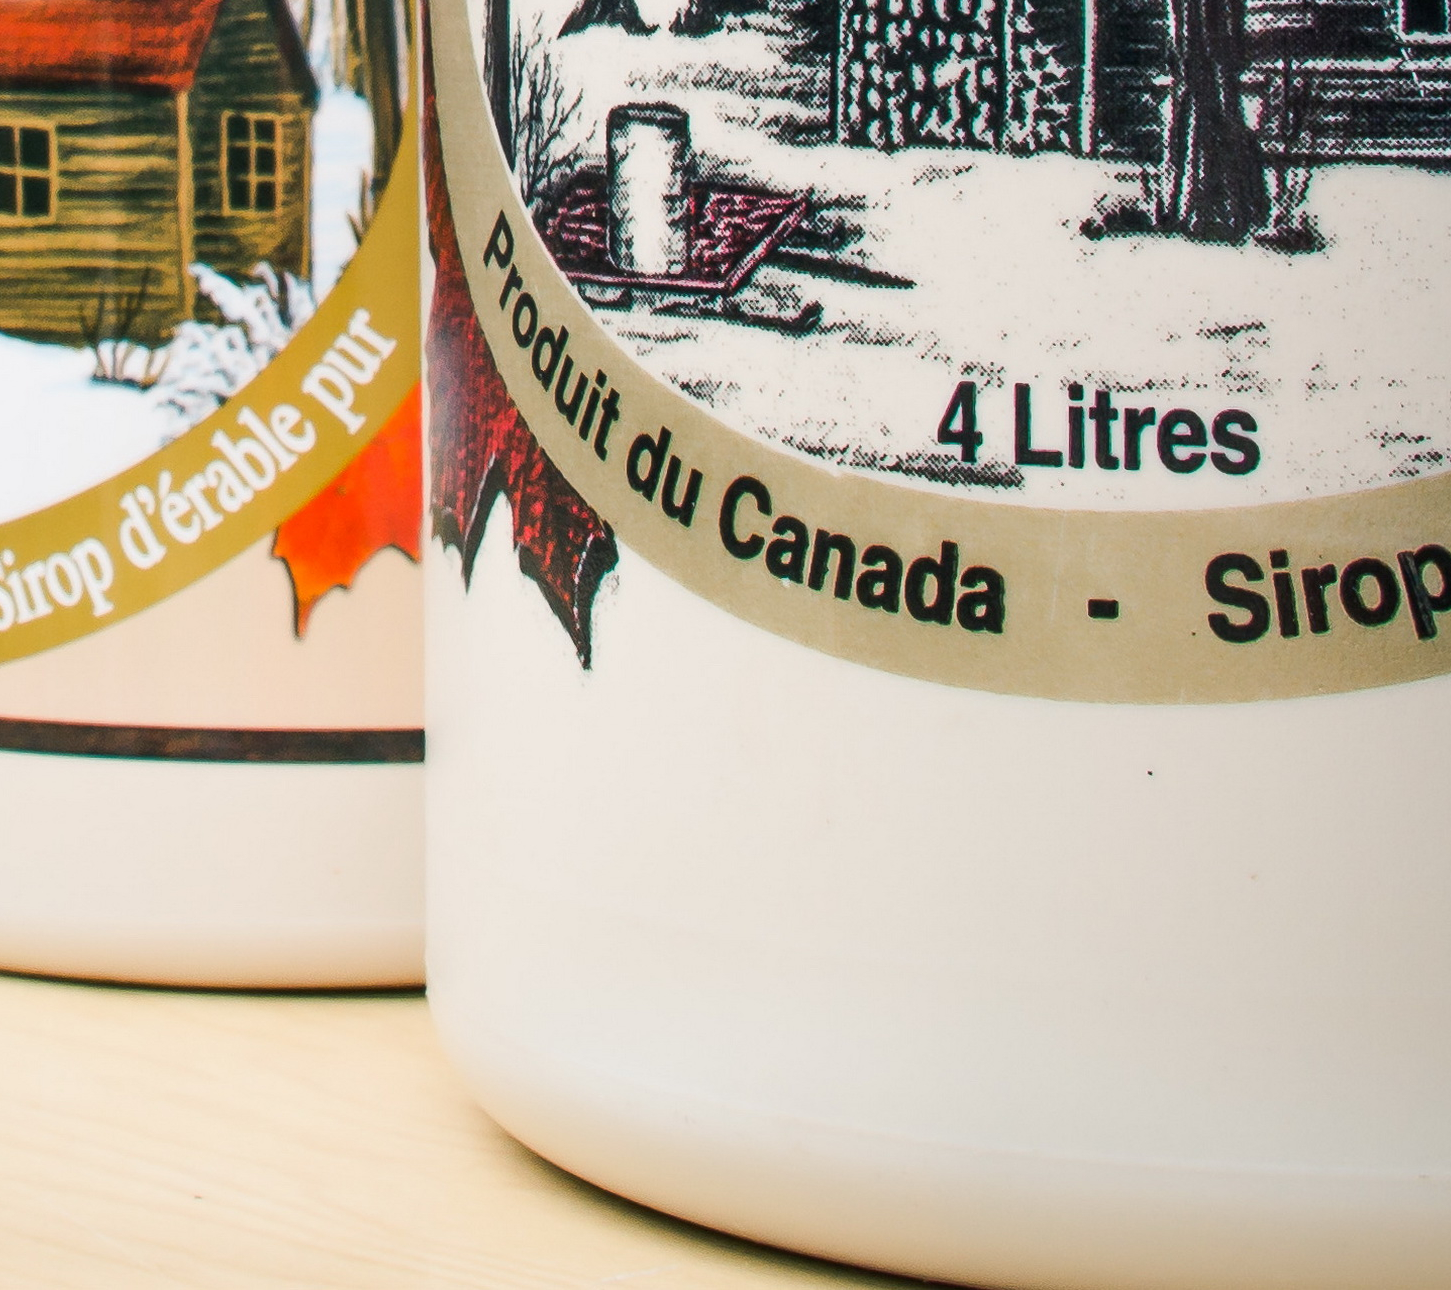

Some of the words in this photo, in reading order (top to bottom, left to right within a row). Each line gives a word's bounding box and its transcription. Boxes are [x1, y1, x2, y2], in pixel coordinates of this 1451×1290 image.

[302, 307, 398, 435] pur
[483, 209, 621, 462] Produit
[626, 425, 704, 528] du
[718, 474, 1007, 635] Canada
[937, 380, 984, 464] 4
[1013, 382, 1262, 476] Litres
